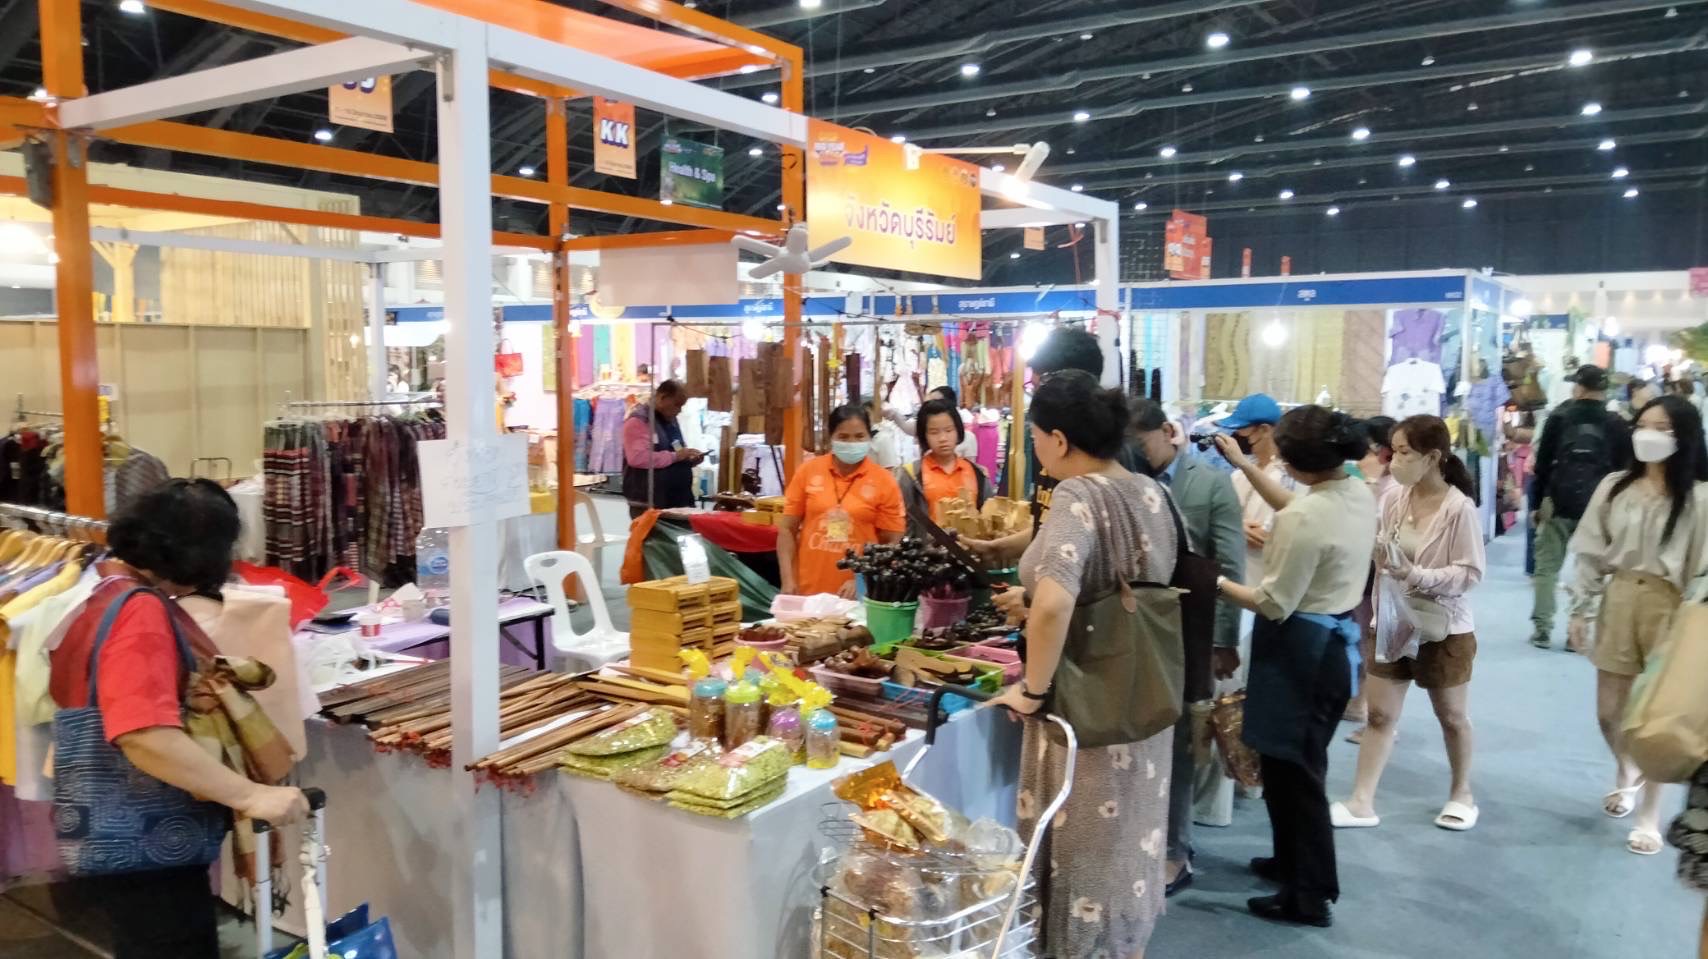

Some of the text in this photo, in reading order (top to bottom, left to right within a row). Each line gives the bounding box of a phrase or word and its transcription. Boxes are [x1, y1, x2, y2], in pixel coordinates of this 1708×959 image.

[601, 118, 629, 147] KK
[669, 161, 716, 184] Health & Spa
